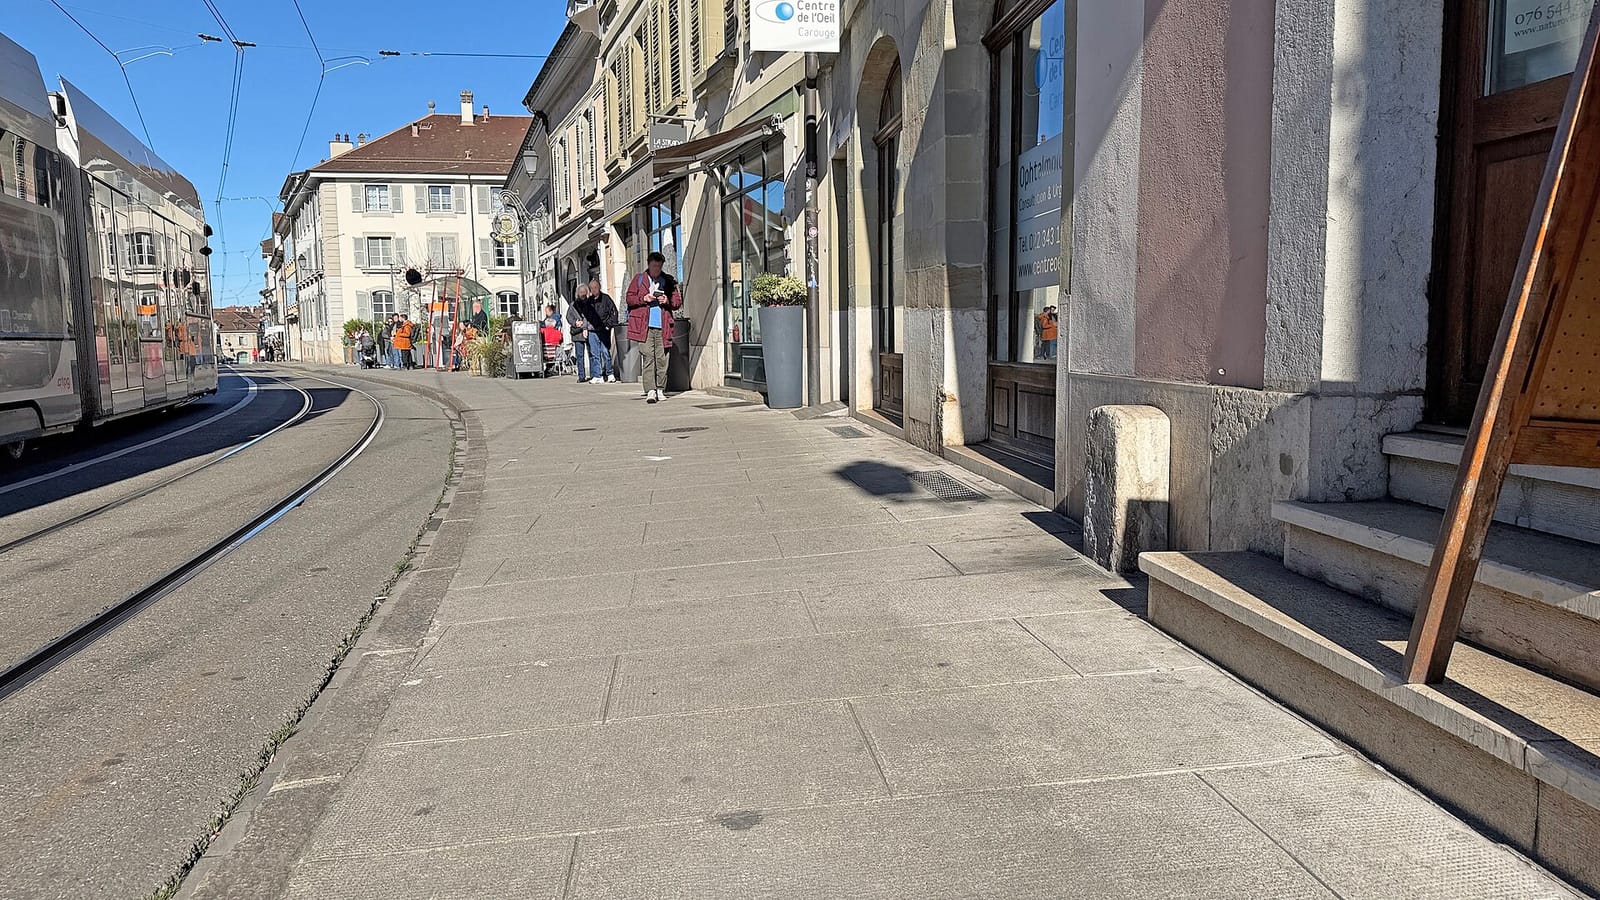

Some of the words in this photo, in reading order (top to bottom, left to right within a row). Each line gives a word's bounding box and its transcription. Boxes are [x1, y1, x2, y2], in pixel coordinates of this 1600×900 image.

[797, 0, 835, 11] Centre
[797, 12, 809, 23] de
[811, 12, 835, 23] l'Oeil
[1515, 6, 1542, 25] 076
[798, 27, 835, 39] Carouge
[1042, 227, 1054, 247] 343
